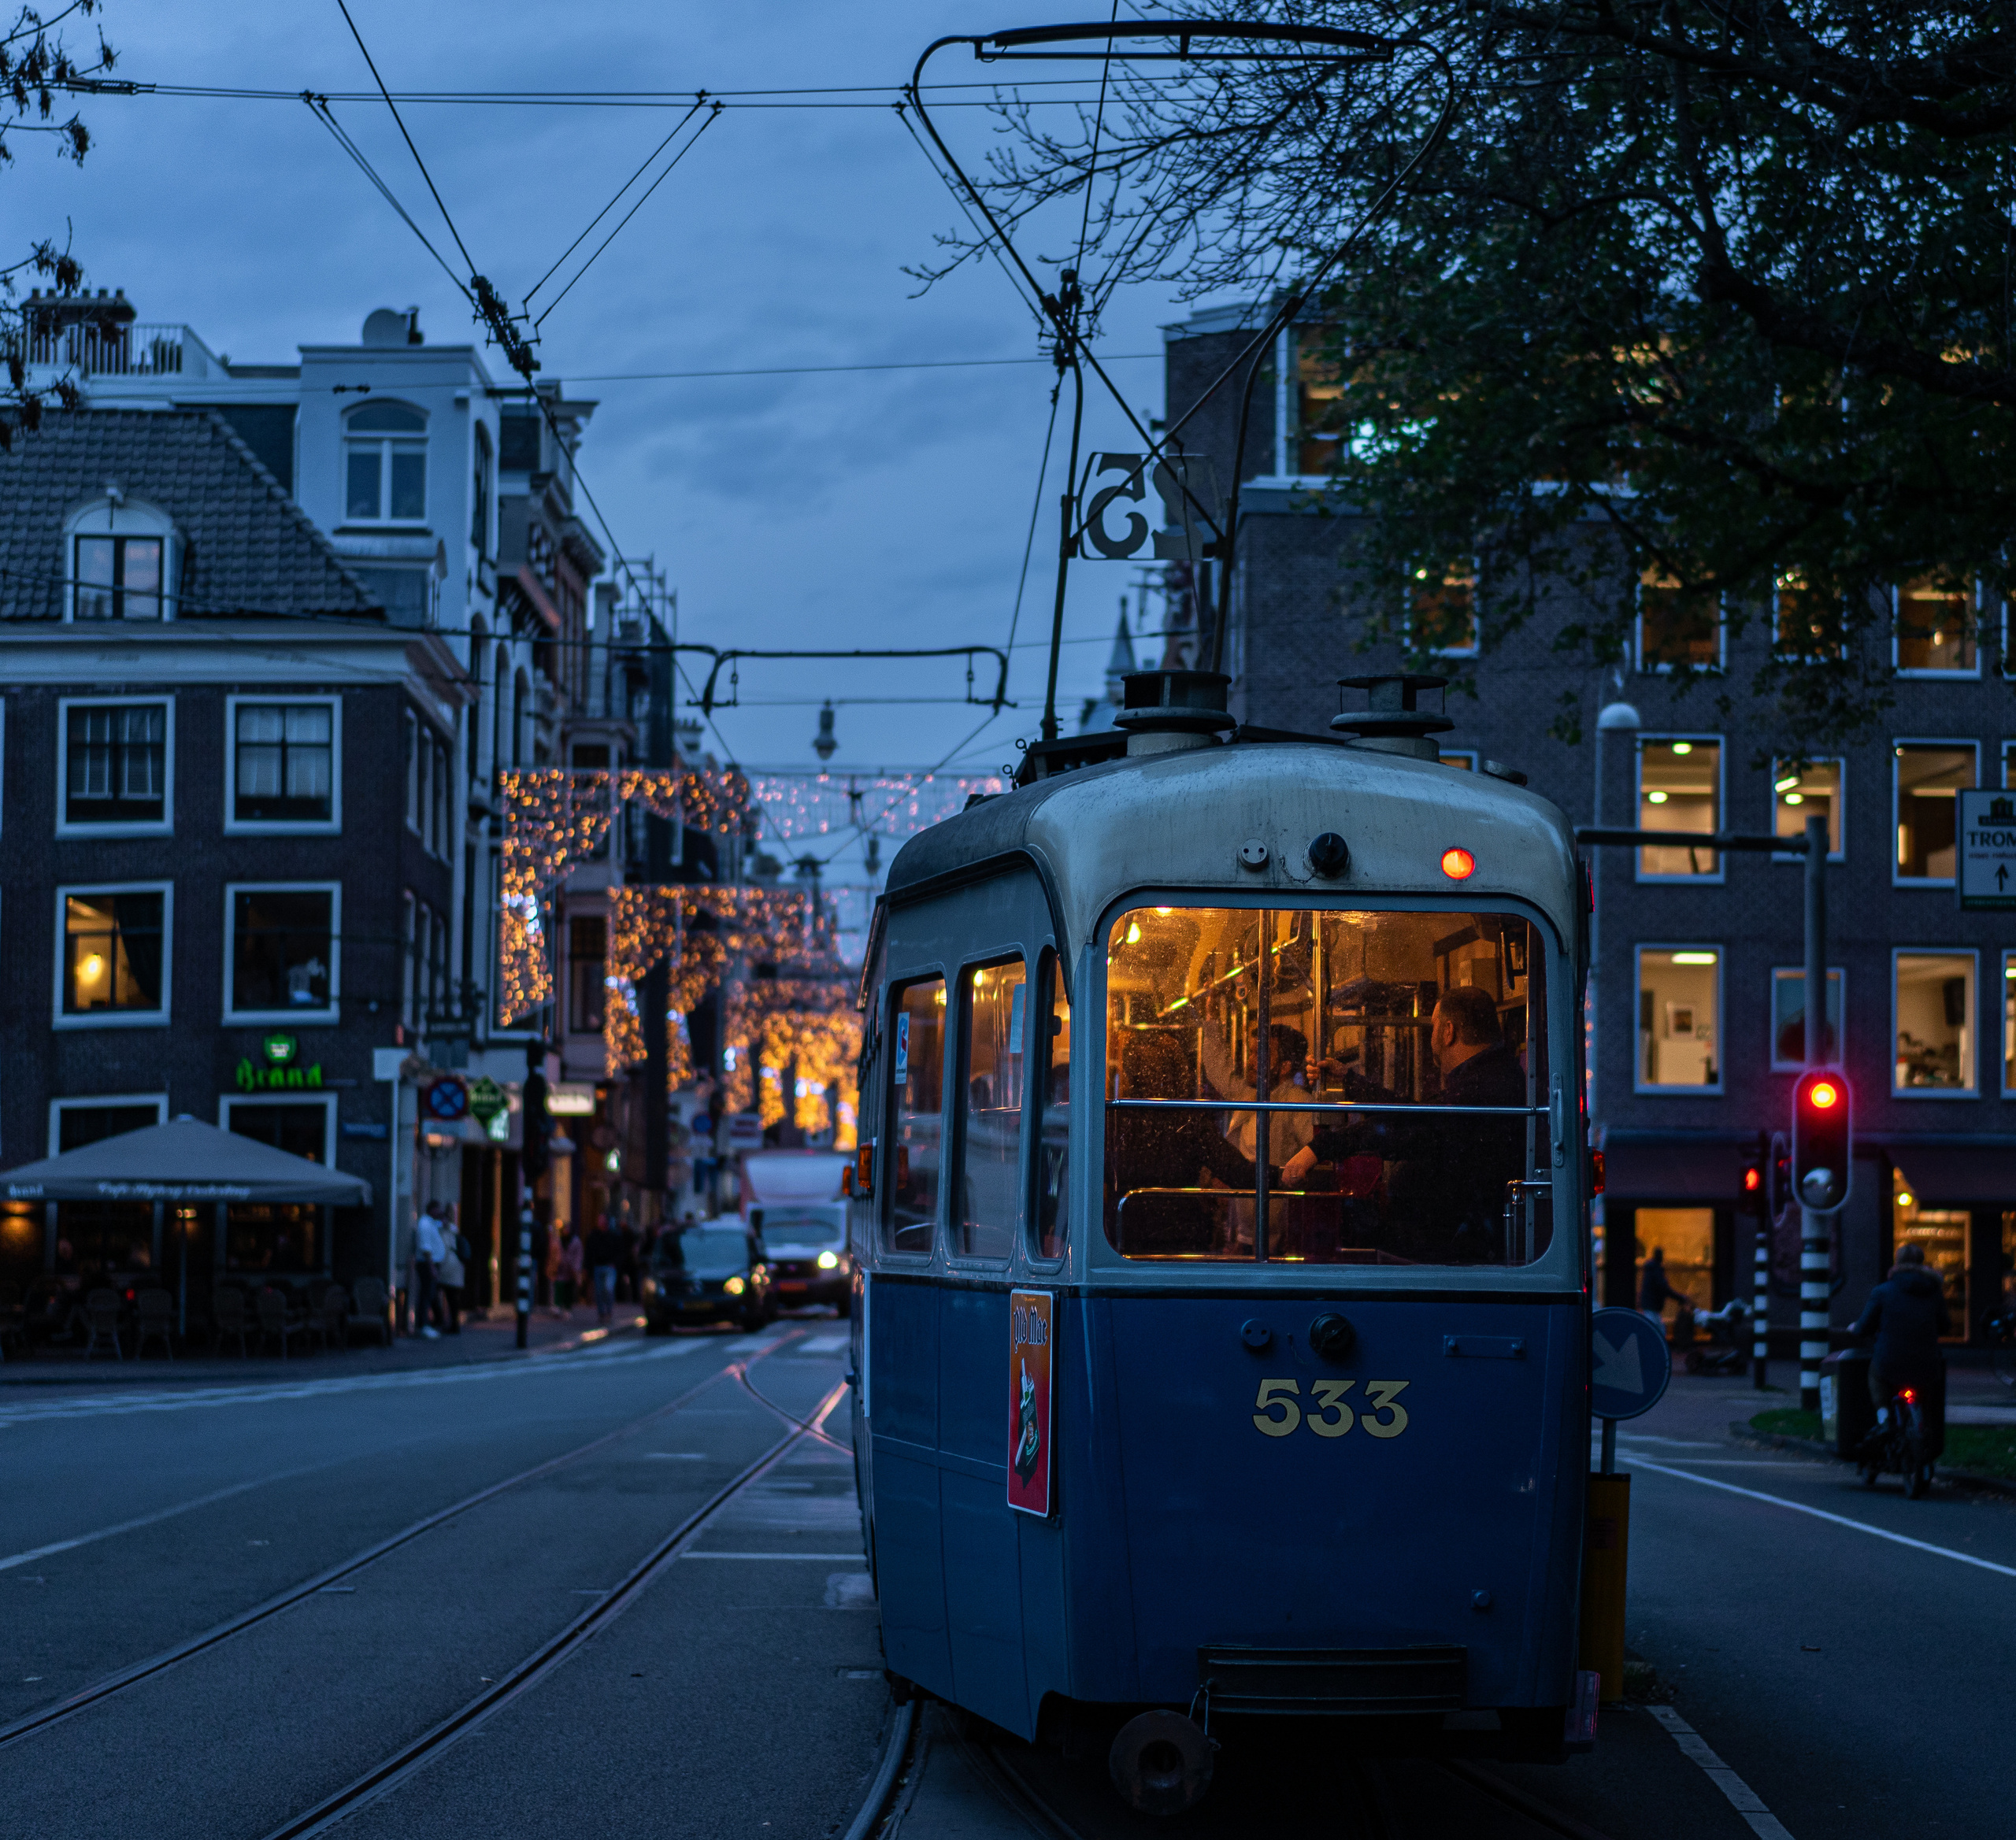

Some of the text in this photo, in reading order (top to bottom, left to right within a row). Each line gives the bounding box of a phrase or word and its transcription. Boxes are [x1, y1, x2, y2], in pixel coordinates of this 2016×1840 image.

[235, 1057, 323, 1093] Brand
[1014, 1305, 1048, 1354] Old Mac
[1251, 1378, 1410, 1438] 533
